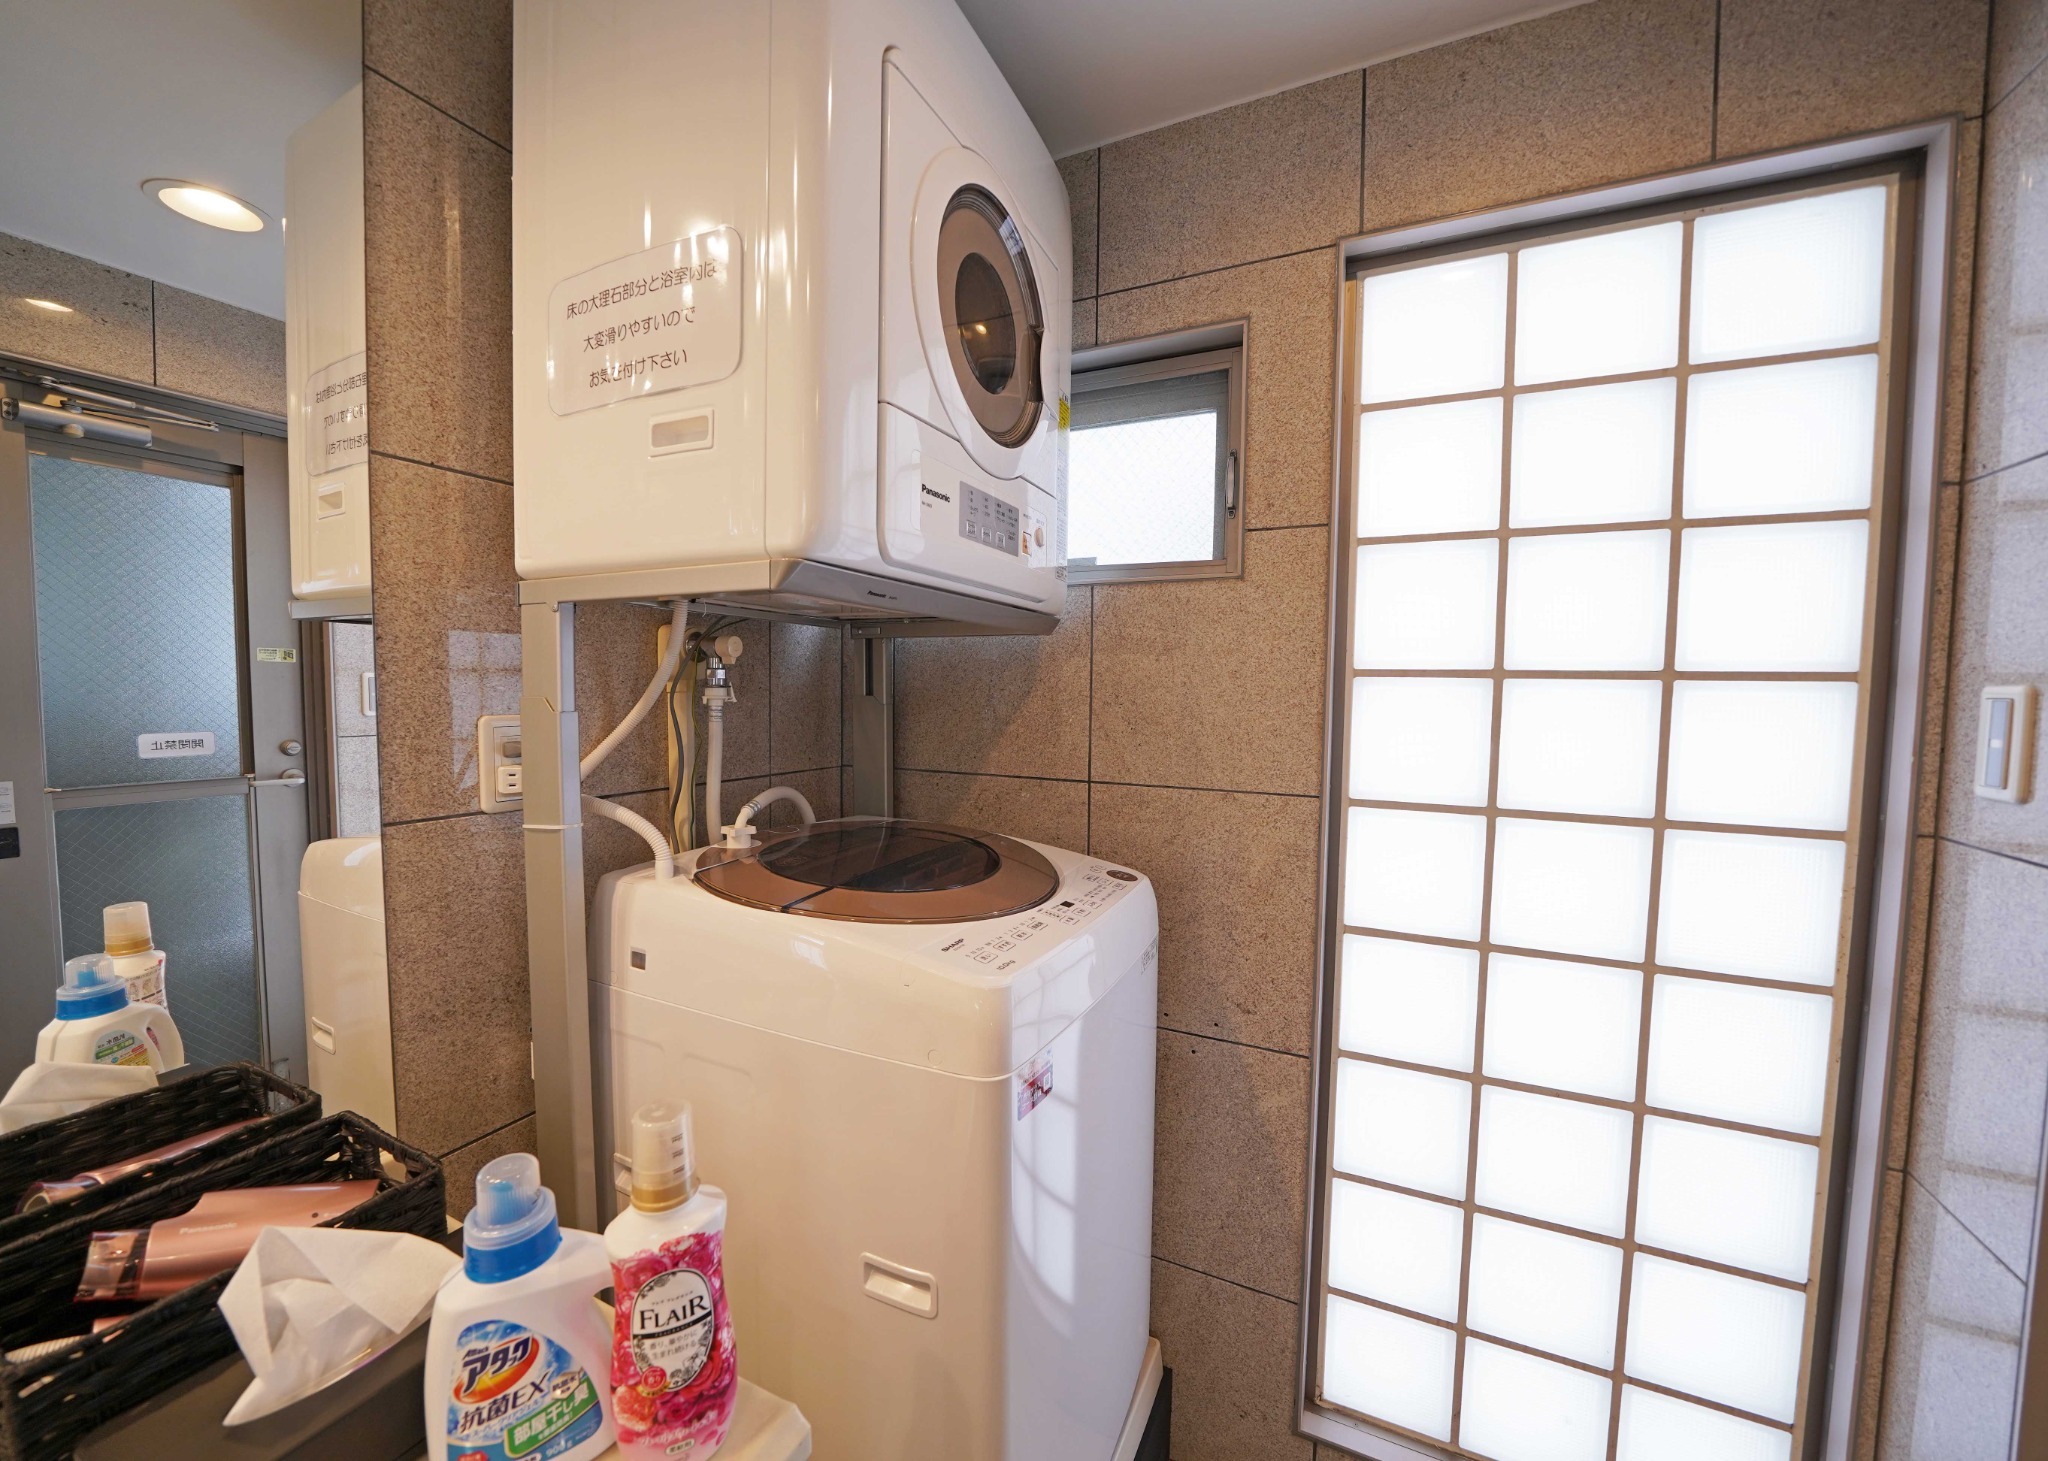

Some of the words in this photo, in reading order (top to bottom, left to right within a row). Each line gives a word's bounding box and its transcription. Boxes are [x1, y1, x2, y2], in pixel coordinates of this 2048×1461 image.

[566, 259, 717, 320] 床の大理石部分と浴室内は
[583, 306, 696, 353] 大変滑りやすいので
[589, 349, 688, 388] お気を付け下さい
[921, 484, 951, 503] Panasonic
[640, 1295, 710, 1330] FLAIR
[462, 1336, 533, 1395] アタック
[460, 1371, 550, 1434] 抗菌EX
